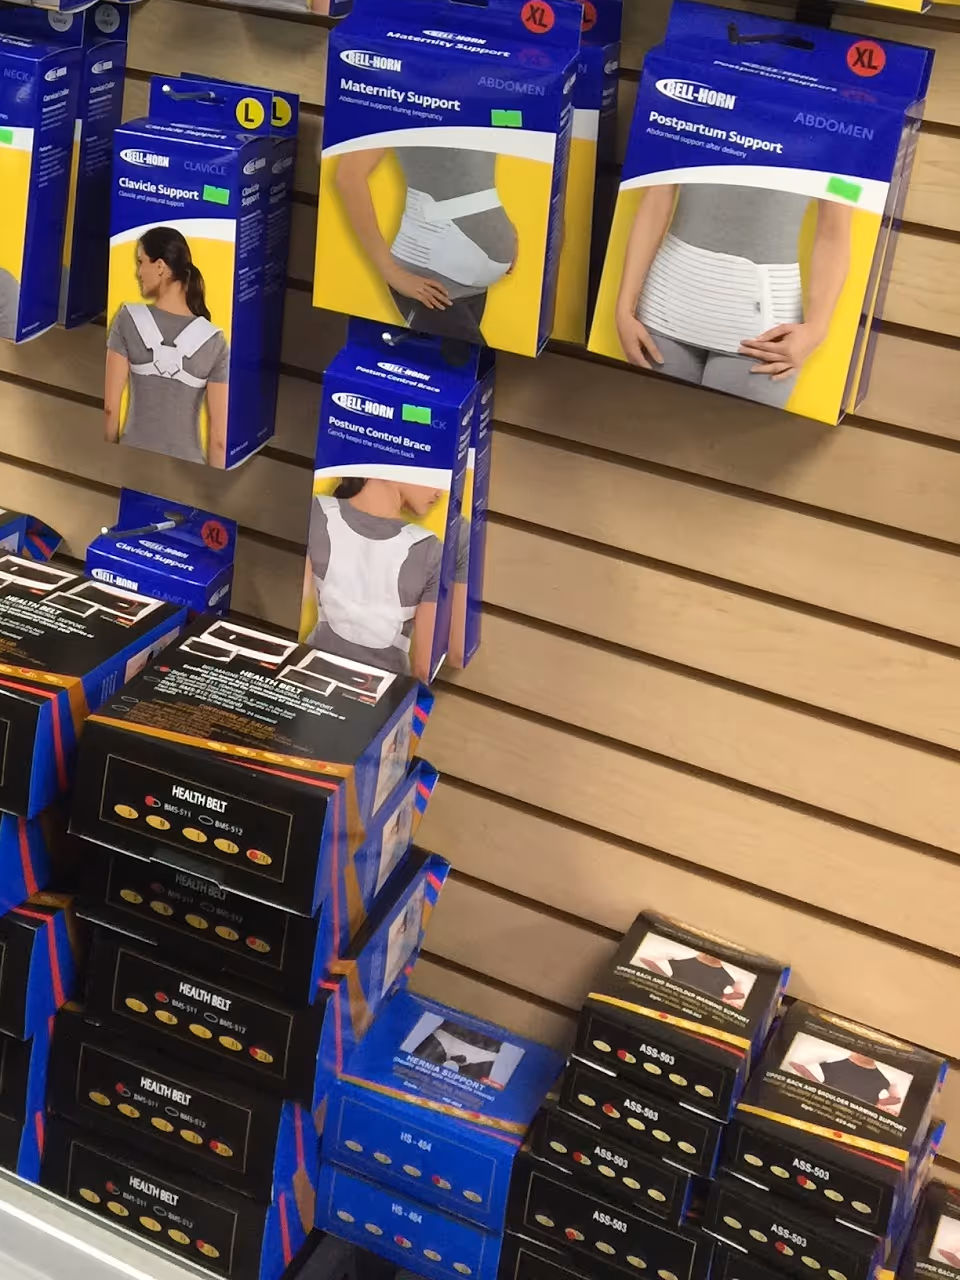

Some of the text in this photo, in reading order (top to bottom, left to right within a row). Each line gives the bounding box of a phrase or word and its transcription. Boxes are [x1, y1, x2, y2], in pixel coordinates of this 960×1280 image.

[526, 5, 547, 29] XL
[387, 31, 510, 57] Maternity Support
[347, 52, 401, 73] BELL-HORN
[851, 46, 878, 70] XL
[4, 68, 29, 82] NECK
[478, 76, 545, 97] ABDOMEN
[340, 77, 461, 112] Maternity Support
[666, 81, 737, 110] BELL-HORN
[244, 103, 254, 123] L
[272, 102, 282, 121] L
[649, 111, 783, 155] Postpartum Support
[793, 111, 874, 141] ABDOMEN
[126, 150, 170, 168] BELL-HORN
[184, 160, 227, 175] CLAVICLE
[119, 177, 199, 201] Clavicle Support
[340, 394, 394, 420] BELL-HORN
[329, 416, 431, 452] Posture Control Brace
[207, 527, 223, 546] XL
[115, 542, 194, 572] Clavicle Support
[96, 570, 139, 591] BELL-HORN
[171, 784, 228, 814] HEALTH BELT
[163, 802, 244, 836] BMS-511 BMS-512
[616, 965, 636, 976] UPPER
[636, 971, 652, 980] BACK
[652, 977, 665, 986] AND
[179, 982, 232, 1012] HEALTH BELT
[639, 1044, 675, 1065] ASS-503
[406, 1054, 440, 1074] HERNIA
[440, 1067, 486, 1091] SUPPORT
[623, 1099, 659, 1121] ASS-503
[765, 1071, 786, 1082] UPPER
[786, 1078, 803, 1088] BACK
[803, 1085, 817, 1095] AND
[817, 1089, 850, 1106] SHOULDER
[878, 1115, 908, 1132] SUPPORT
[594, 1146, 629, 1168] ASS-503
[792, 1158, 830, 1180] ASS-503
[592, 1211, 627, 1233] ASS-503
[770, 1223, 807, 1248] ASS-503
